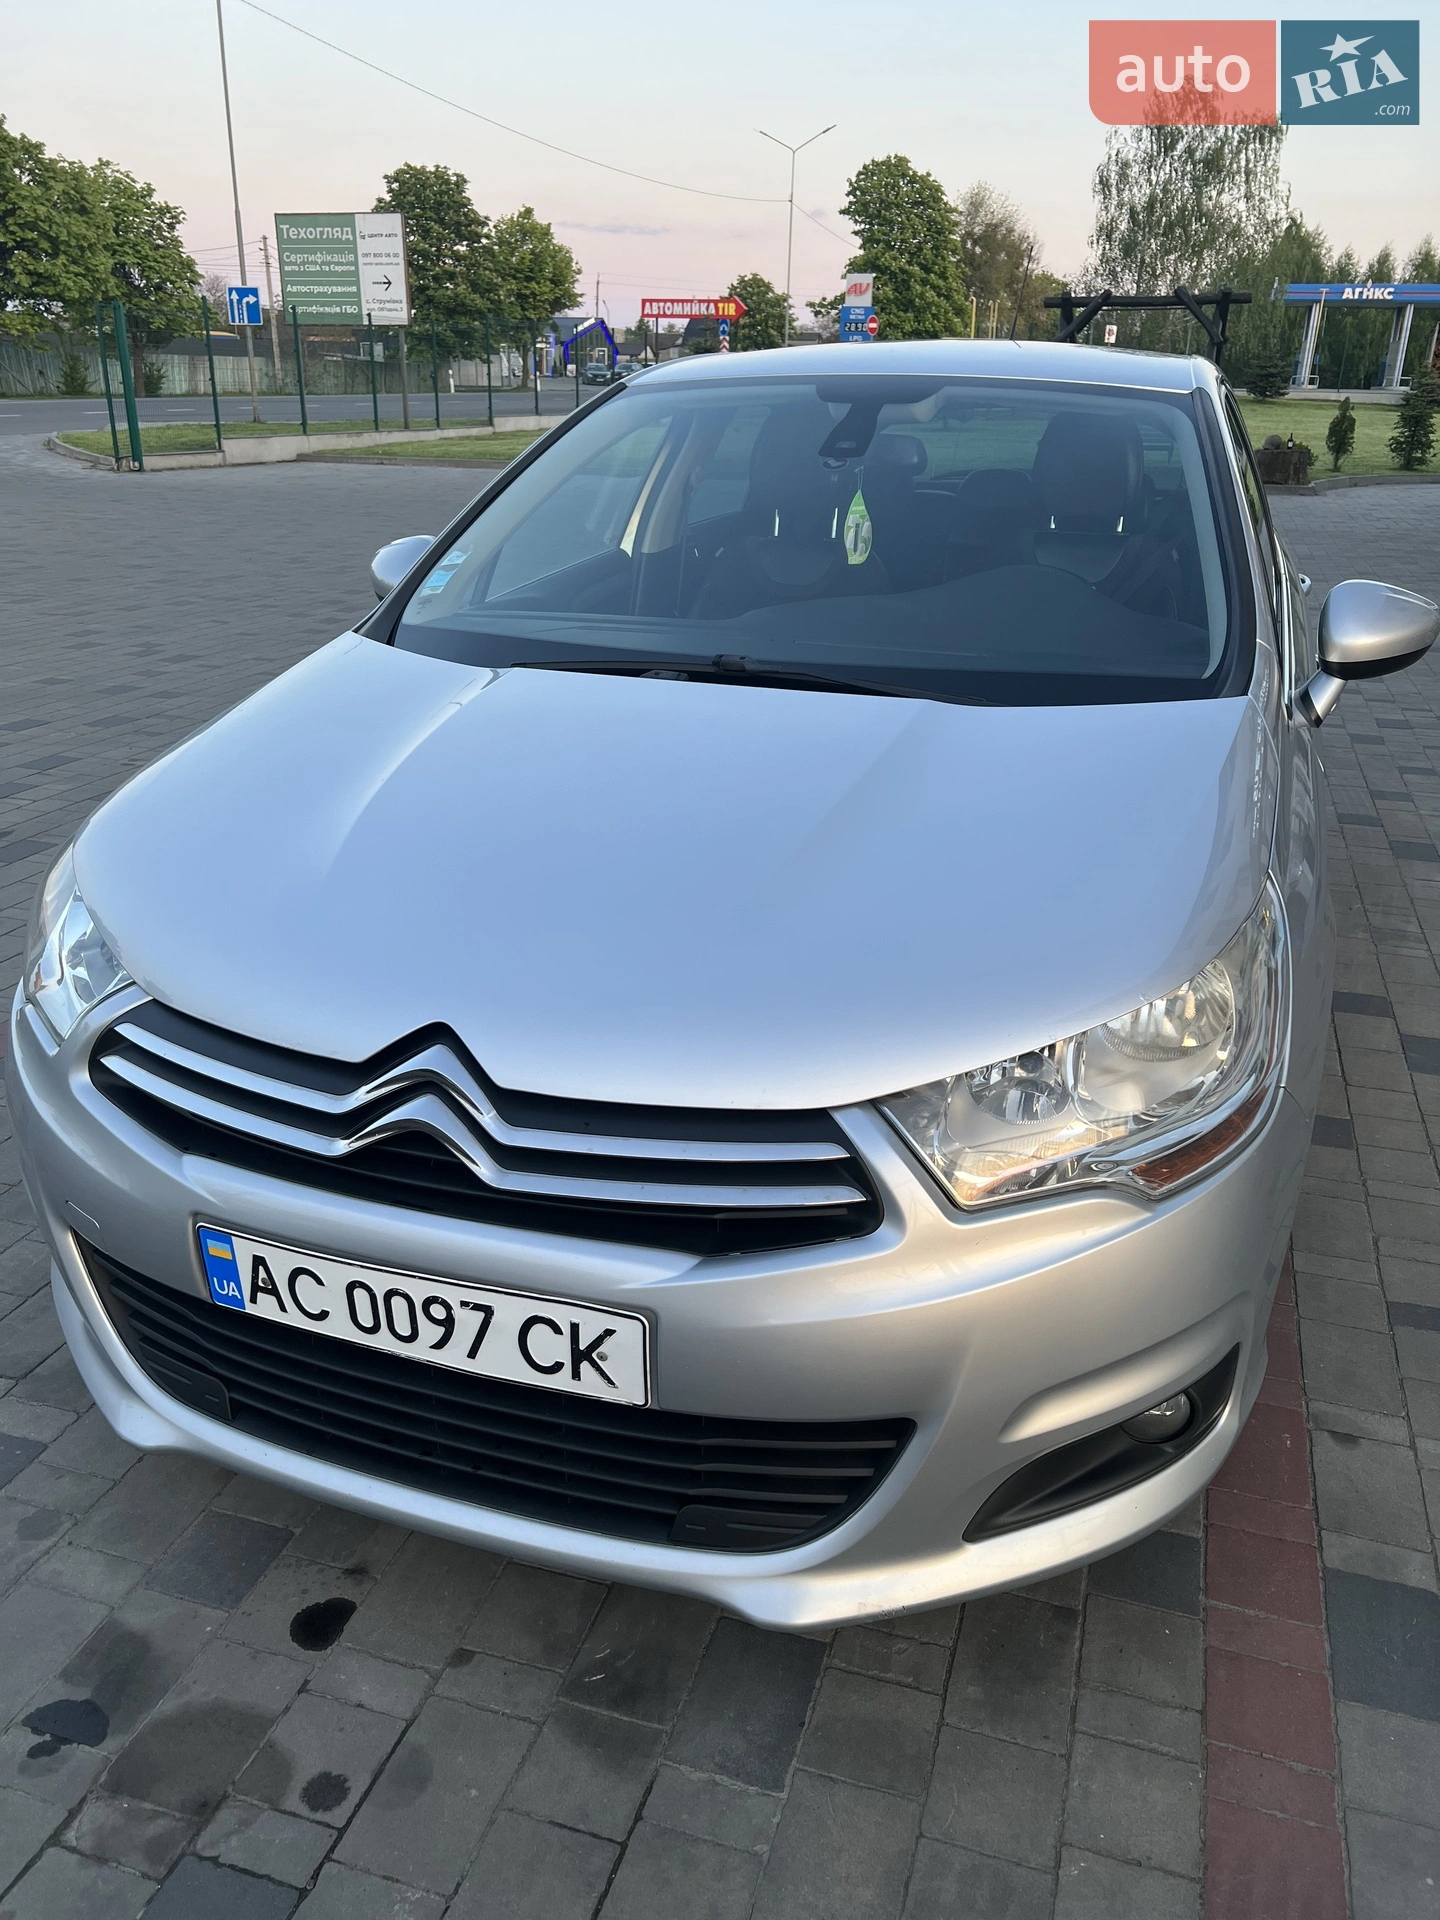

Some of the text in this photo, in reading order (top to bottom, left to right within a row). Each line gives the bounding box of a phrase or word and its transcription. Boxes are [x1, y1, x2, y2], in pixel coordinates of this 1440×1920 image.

[279, 224, 353, 241] Техогляд
[283, 250, 355, 264] Сертифікація
[286, 284, 358, 294] Автострахування
[1342, 287, 1395, 300] АГНКС
[644, 300, 736, 316] АВТОМИЙКА TIR
[212, 1276, 242, 1300] UA
[249, 1254, 619, 1390] AC 0097 CK
